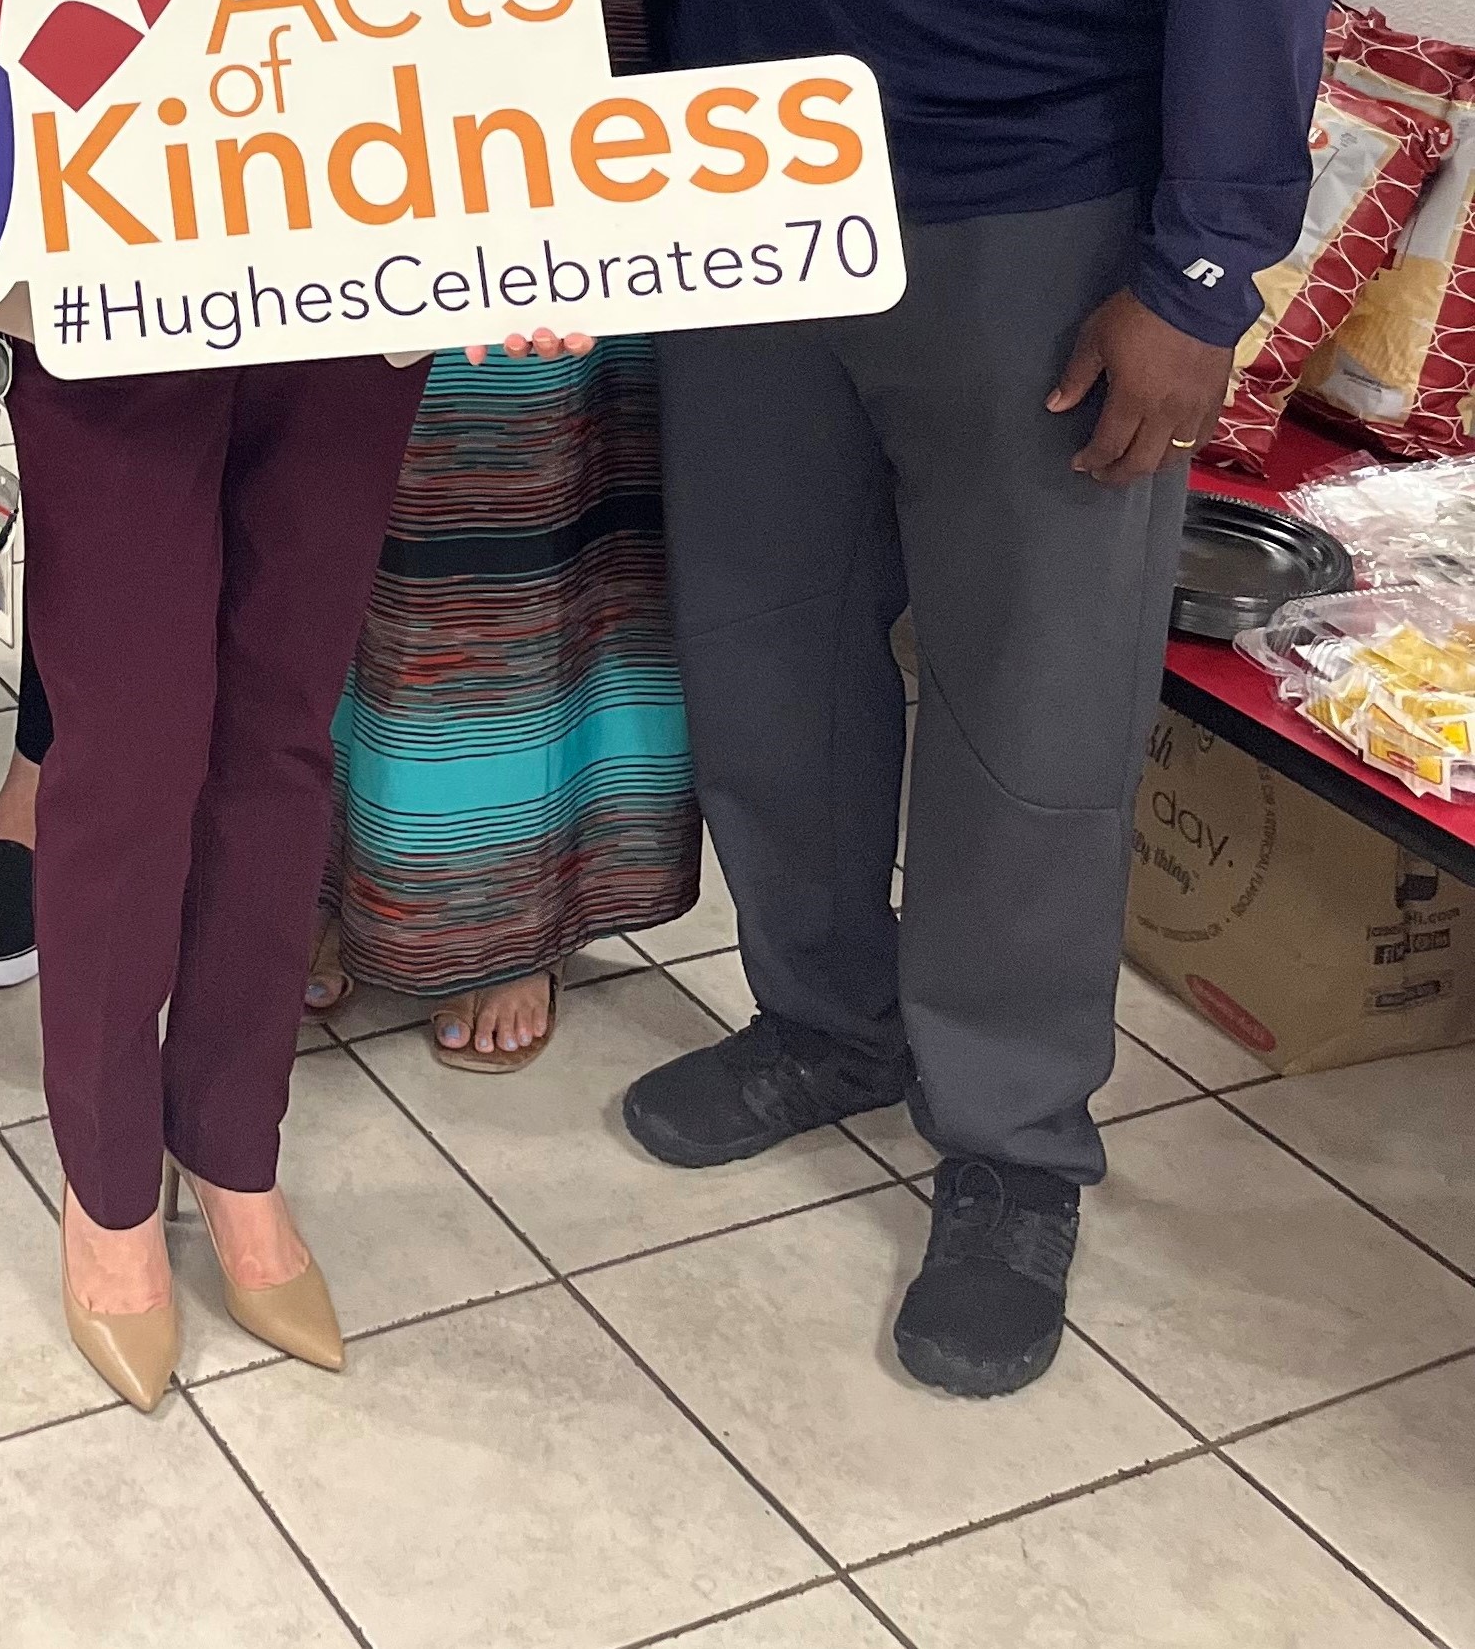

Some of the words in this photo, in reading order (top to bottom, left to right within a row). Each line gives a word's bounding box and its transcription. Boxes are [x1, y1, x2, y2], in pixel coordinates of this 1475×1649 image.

[209, 25, 292, 118] of
[32, 64, 864, 253] Kindness
[53, 214, 879, 349] #HughesCelebrates70
